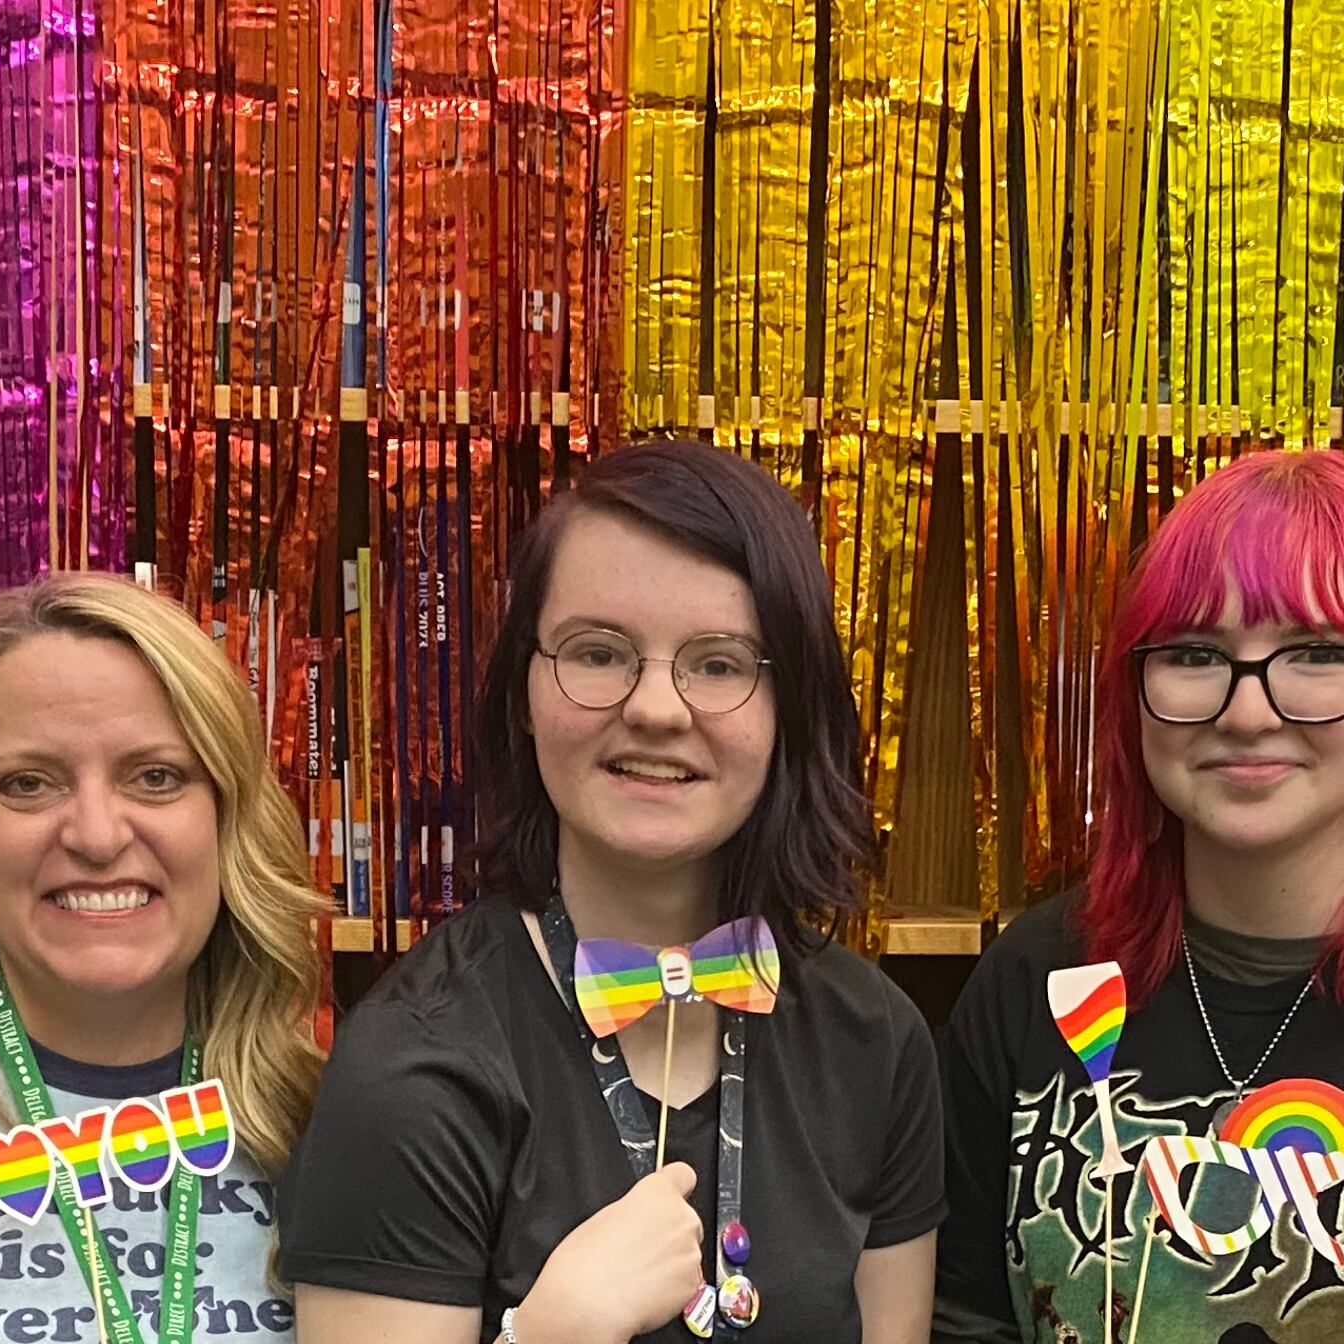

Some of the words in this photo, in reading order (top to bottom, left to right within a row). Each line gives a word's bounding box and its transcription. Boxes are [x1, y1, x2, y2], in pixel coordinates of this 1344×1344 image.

[21, 1088, 47, 1124] DELEG
[39, 1078, 235, 1208] YOU
[171, 1223, 190, 1267] DISTRACT
